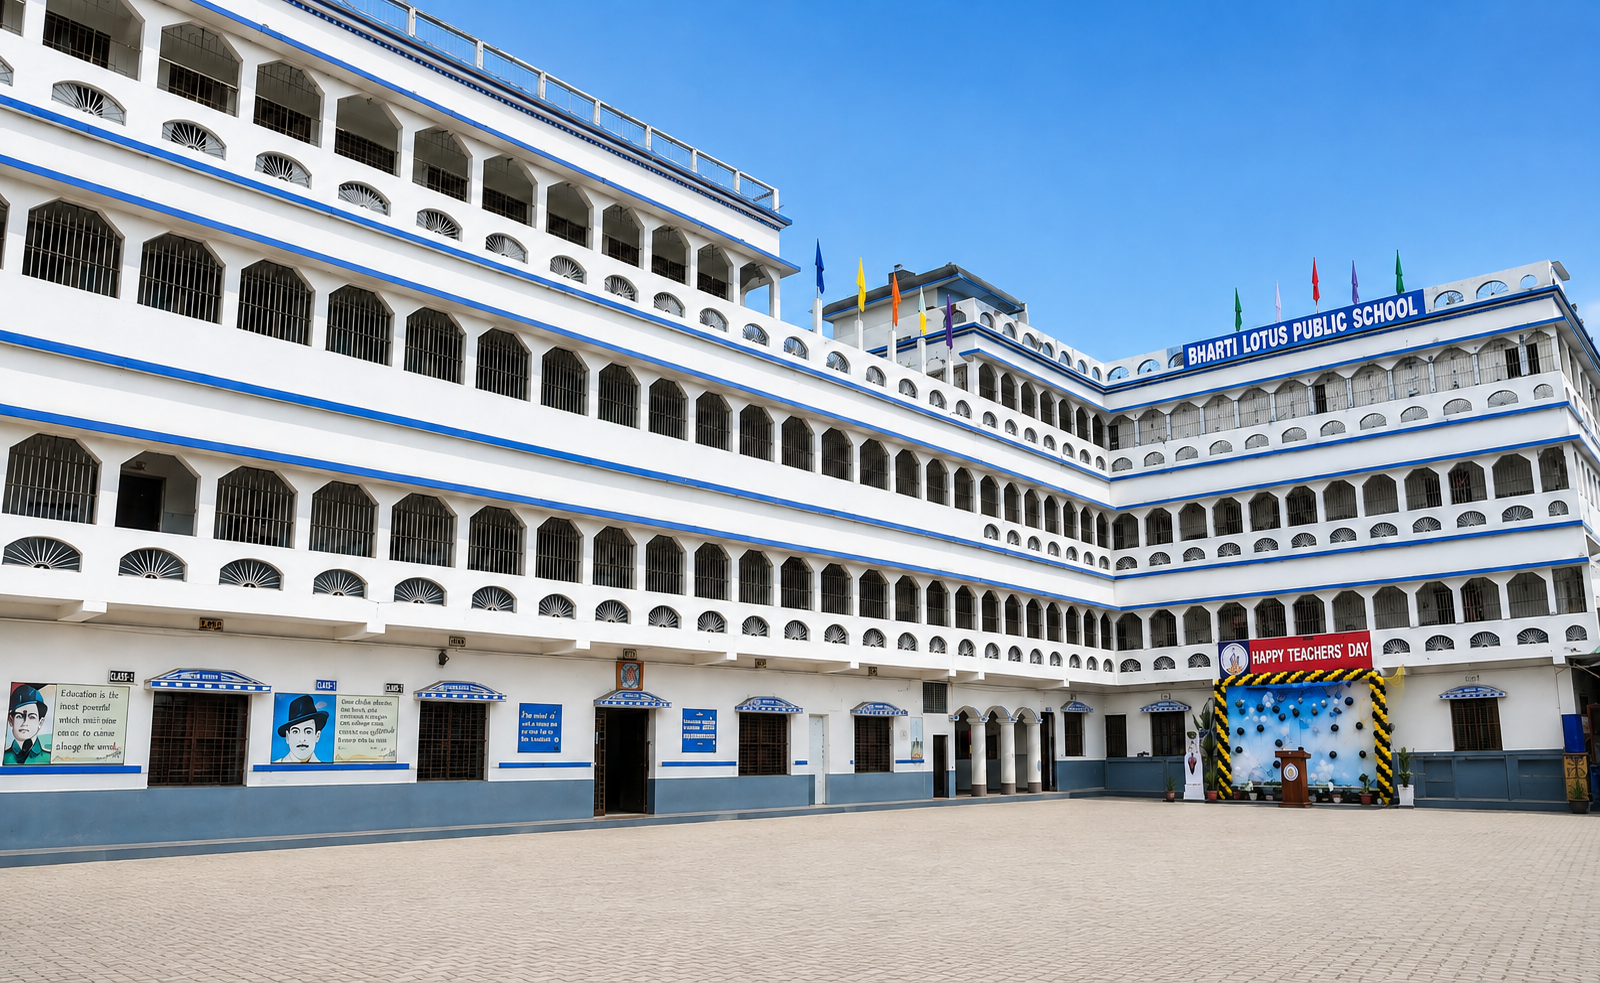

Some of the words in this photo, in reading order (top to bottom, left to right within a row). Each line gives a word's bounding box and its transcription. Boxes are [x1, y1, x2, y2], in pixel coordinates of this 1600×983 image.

[1188, 337, 1237, 365] BHARTI
[1242, 325, 1288, 354] LOTUS
[1293, 312, 1347, 342] PUBLIC
[1353, 296, 1418, 328] SCHOOL
[1252, 649, 1284, 665] HAPPY
[1287, 643, 1344, 662] TEACHERS'
[1348, 641, 1369, 658] DAY
[61, 689, 97, 699] Education
[100, 690, 106, 699] is
